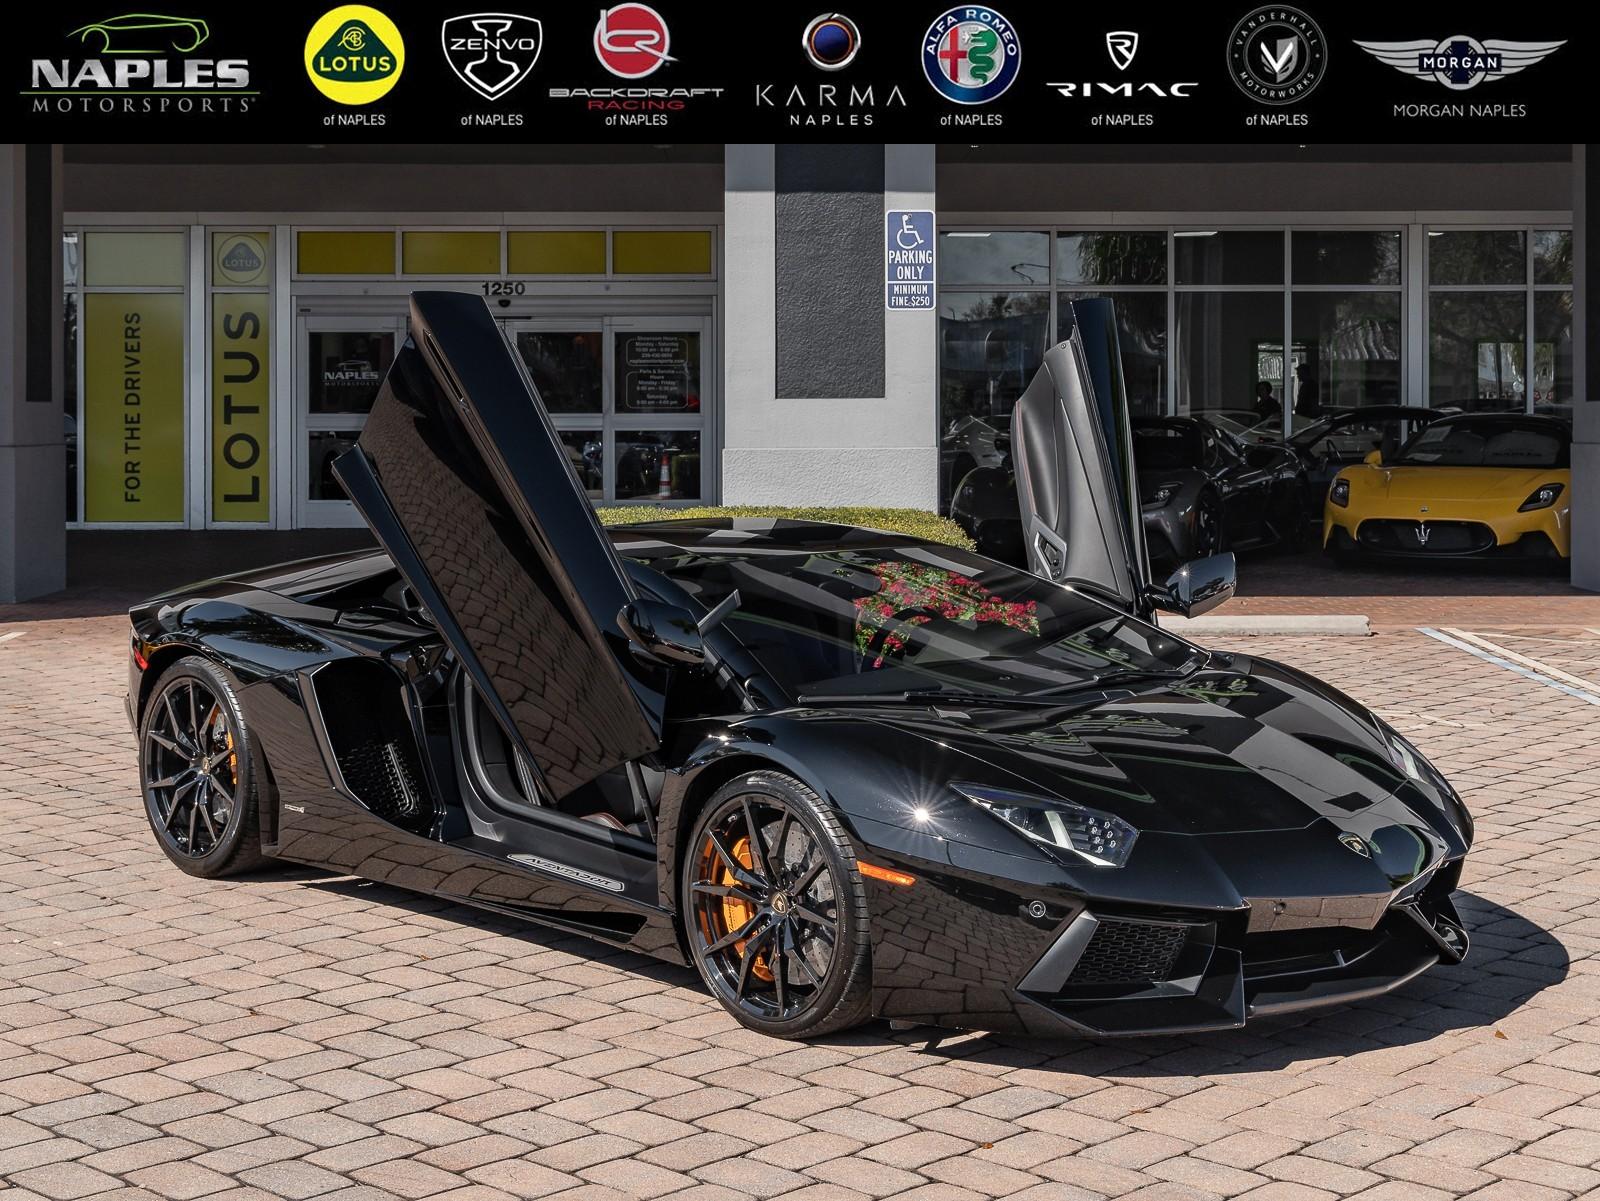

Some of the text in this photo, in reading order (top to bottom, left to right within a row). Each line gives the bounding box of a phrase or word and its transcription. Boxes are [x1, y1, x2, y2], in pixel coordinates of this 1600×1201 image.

[225, 259, 259, 267] LOTUS
[888, 250, 933, 264] PARKING
[896, 265, 924, 280] ONLY
[481, 282, 526, 296] 1250
[893, 284, 928, 295] MINIMUM
[891, 296, 930, 307] FINE $250
[324, 371, 379, 380] NAPLES
[124, 312, 141, 503] FOR THE DRIVERS
[223, 311, 260, 503] LOTUS
